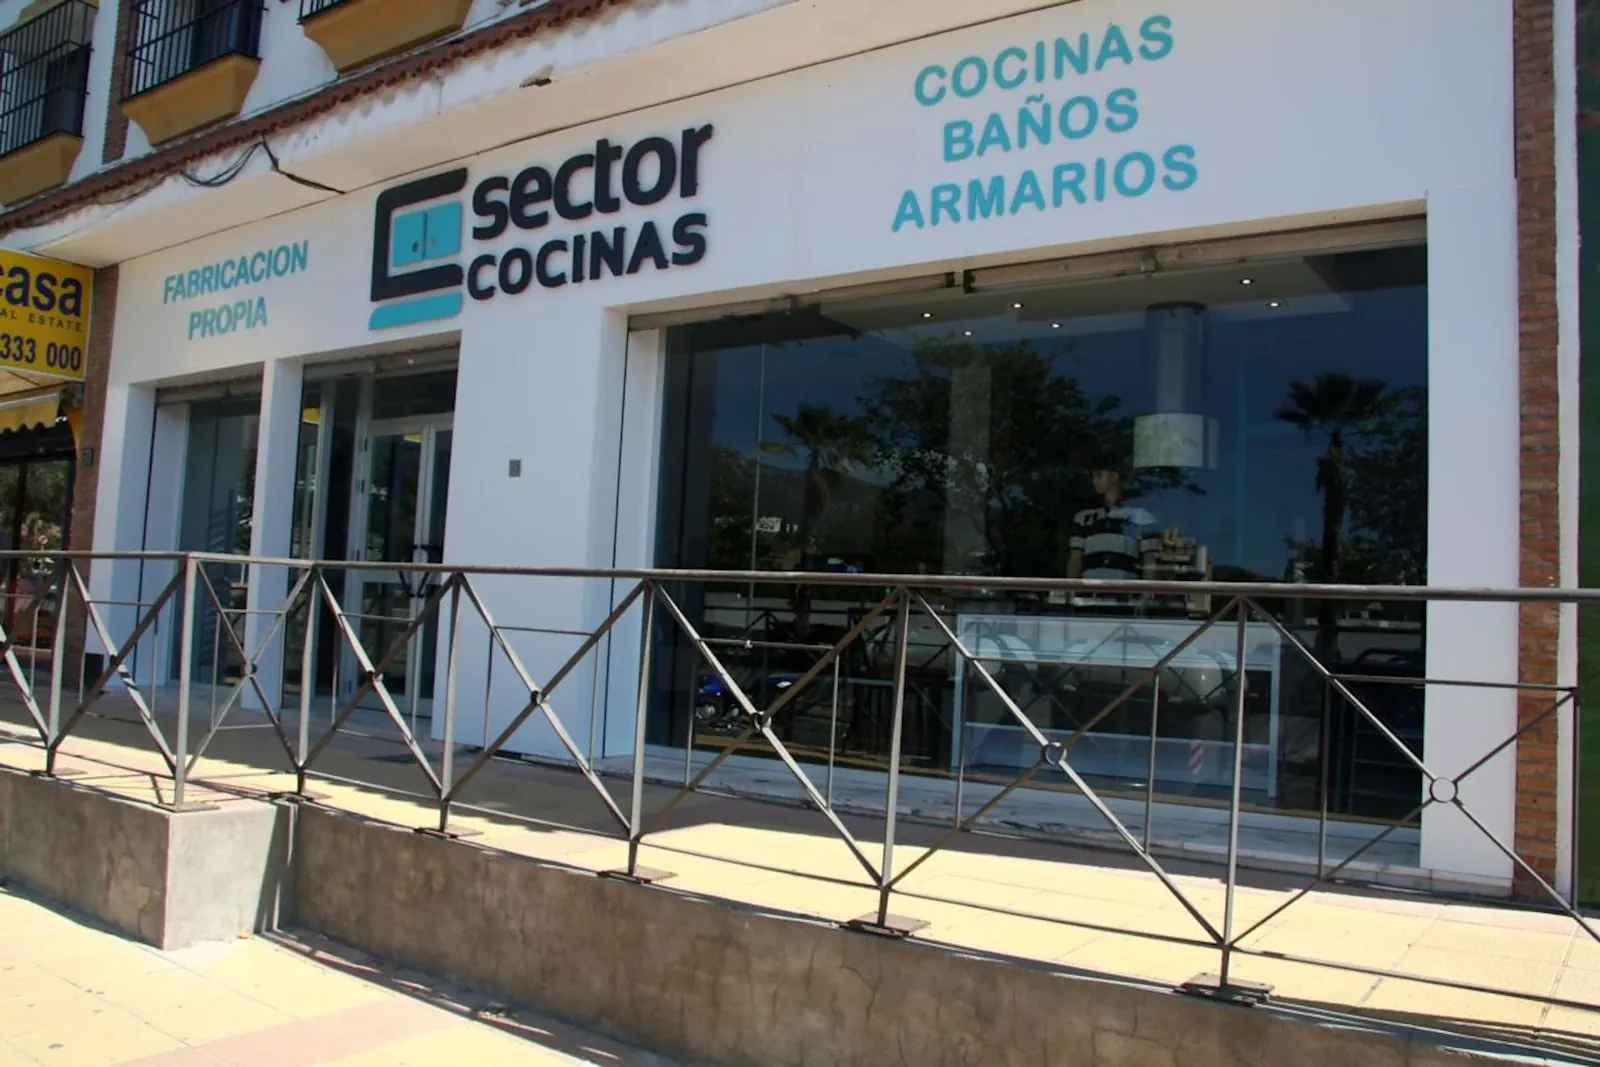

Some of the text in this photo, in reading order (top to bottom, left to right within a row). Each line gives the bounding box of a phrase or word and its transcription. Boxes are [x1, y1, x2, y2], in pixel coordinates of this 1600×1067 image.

[914, 14, 1174, 107] COCINAS
[942, 87, 1139, 163] BAÑOS
[472, 123, 714, 240] sector
[891, 144, 1198, 233] ARMARIOS
[0, 264, 83, 317] asa
[162, 239, 309, 305] FABRICACION
[467, 213, 707, 300] COCINAS
[0, 333, 81, 371] 333 000
[28, 312, 83, 332] ESTATE
[188, 296, 268, 340] PROPIA
